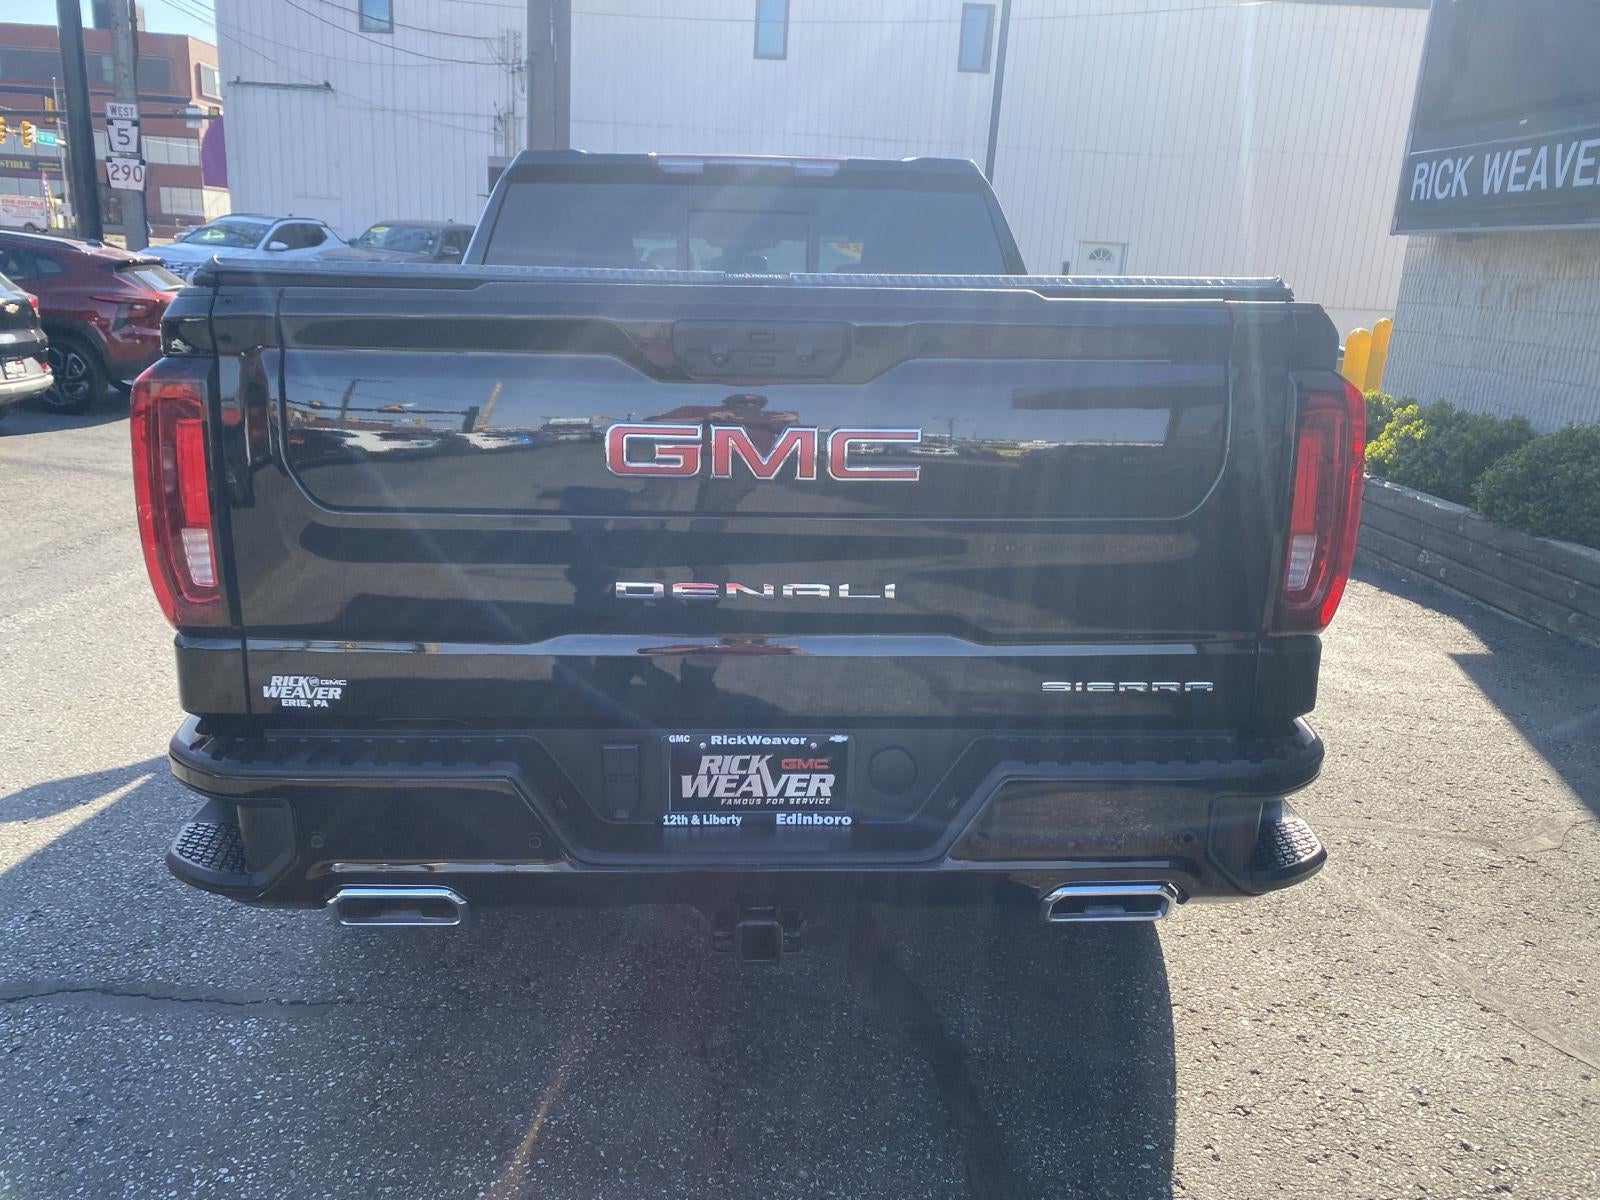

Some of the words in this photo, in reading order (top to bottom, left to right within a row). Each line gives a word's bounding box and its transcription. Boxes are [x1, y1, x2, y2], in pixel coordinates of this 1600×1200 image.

[109, 105, 135, 117] WEST
[117, 127, 130, 146] 5
[110, 163, 143, 183] 290
[1410, 155, 1474, 201] RICK
[1482, 138, 1600, 195] WEAVE
[604, 423, 923, 481] GMC
[615, 582, 896, 600] DENALI
[270, 675, 310, 687] RICK
[1041, 681, 1214, 692] SIERRA
[262, 685, 342, 700] WEAVER
[281, 698, 311, 708] ERIE,
[313, 699, 329, 708] PA
[669, 735, 690, 743] GMC
[711, 735, 807, 745] RickWeaver
[698, 755, 774, 775] RICK
[781, 758, 830, 769] GMC
[681, 774, 835, 798] WEAVER
[662, 814, 689, 826] 12th
[690, 814, 701, 826] &
[702, 813, 743, 827] Liberty
[776, 813, 852, 825] Edinboro
